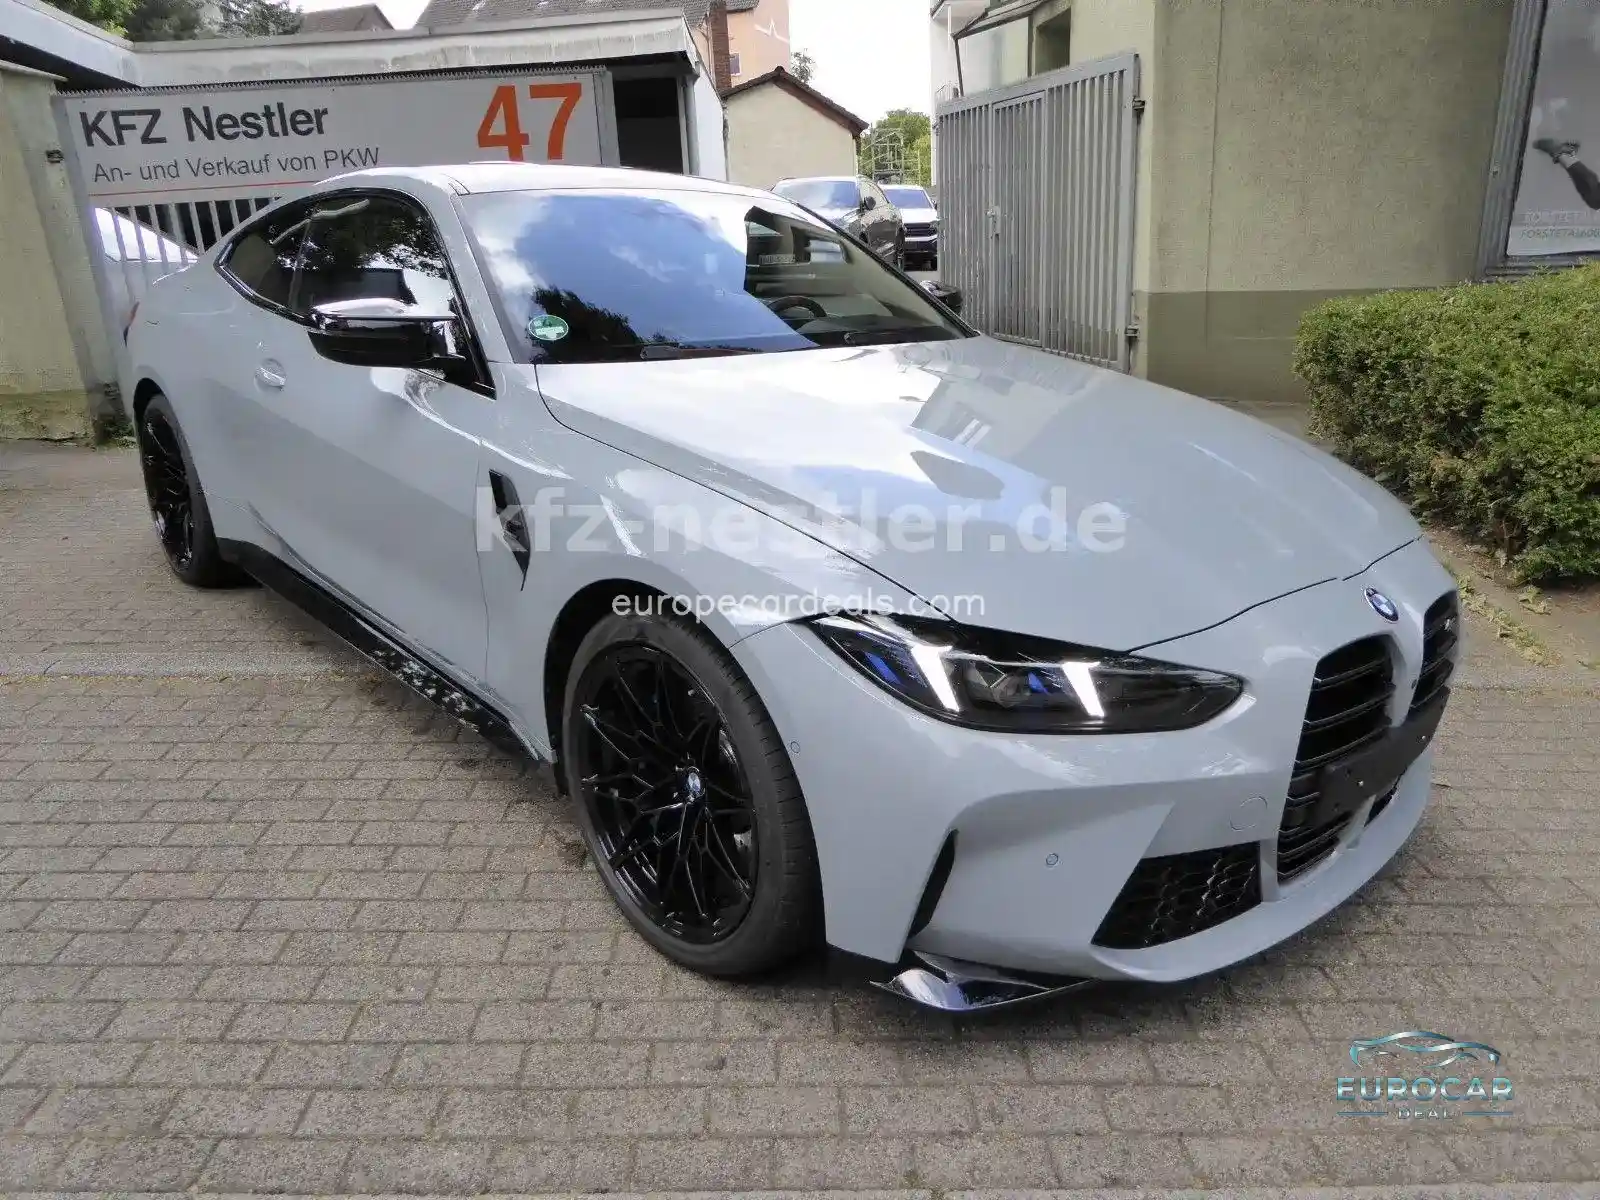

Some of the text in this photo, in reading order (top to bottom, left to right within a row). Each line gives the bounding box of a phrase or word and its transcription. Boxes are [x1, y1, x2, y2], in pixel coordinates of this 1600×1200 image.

[79, 101, 329, 147] KFZ Nestler
[477, 82, 582, 162] 47
[94, 146, 380, 183] An- und Verkauf von PKW
